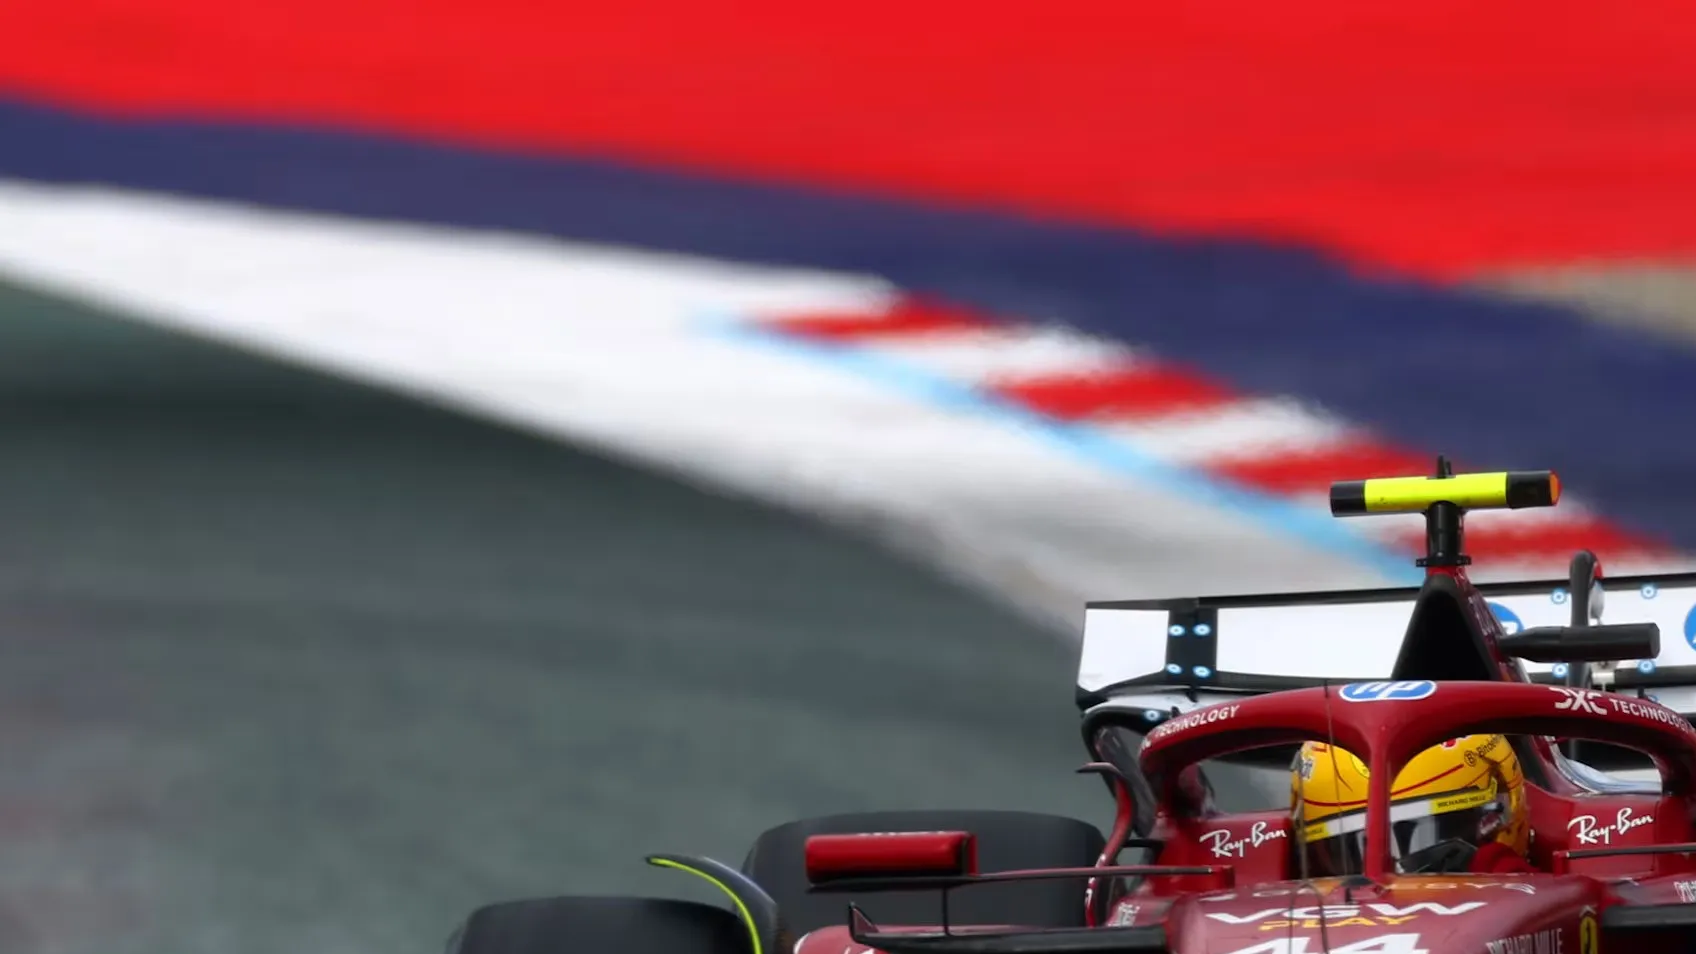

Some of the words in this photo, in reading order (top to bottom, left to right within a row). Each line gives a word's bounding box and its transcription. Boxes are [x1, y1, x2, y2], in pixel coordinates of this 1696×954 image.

[1549, 686, 1608, 715] DXC
[1199, 821, 1287, 858] Ray-Ban
[1567, 807, 1654, 844] Ray-Ban
[1206, 901, 1488, 925] VGW
[1259, 915, 1420, 932] PLAY
